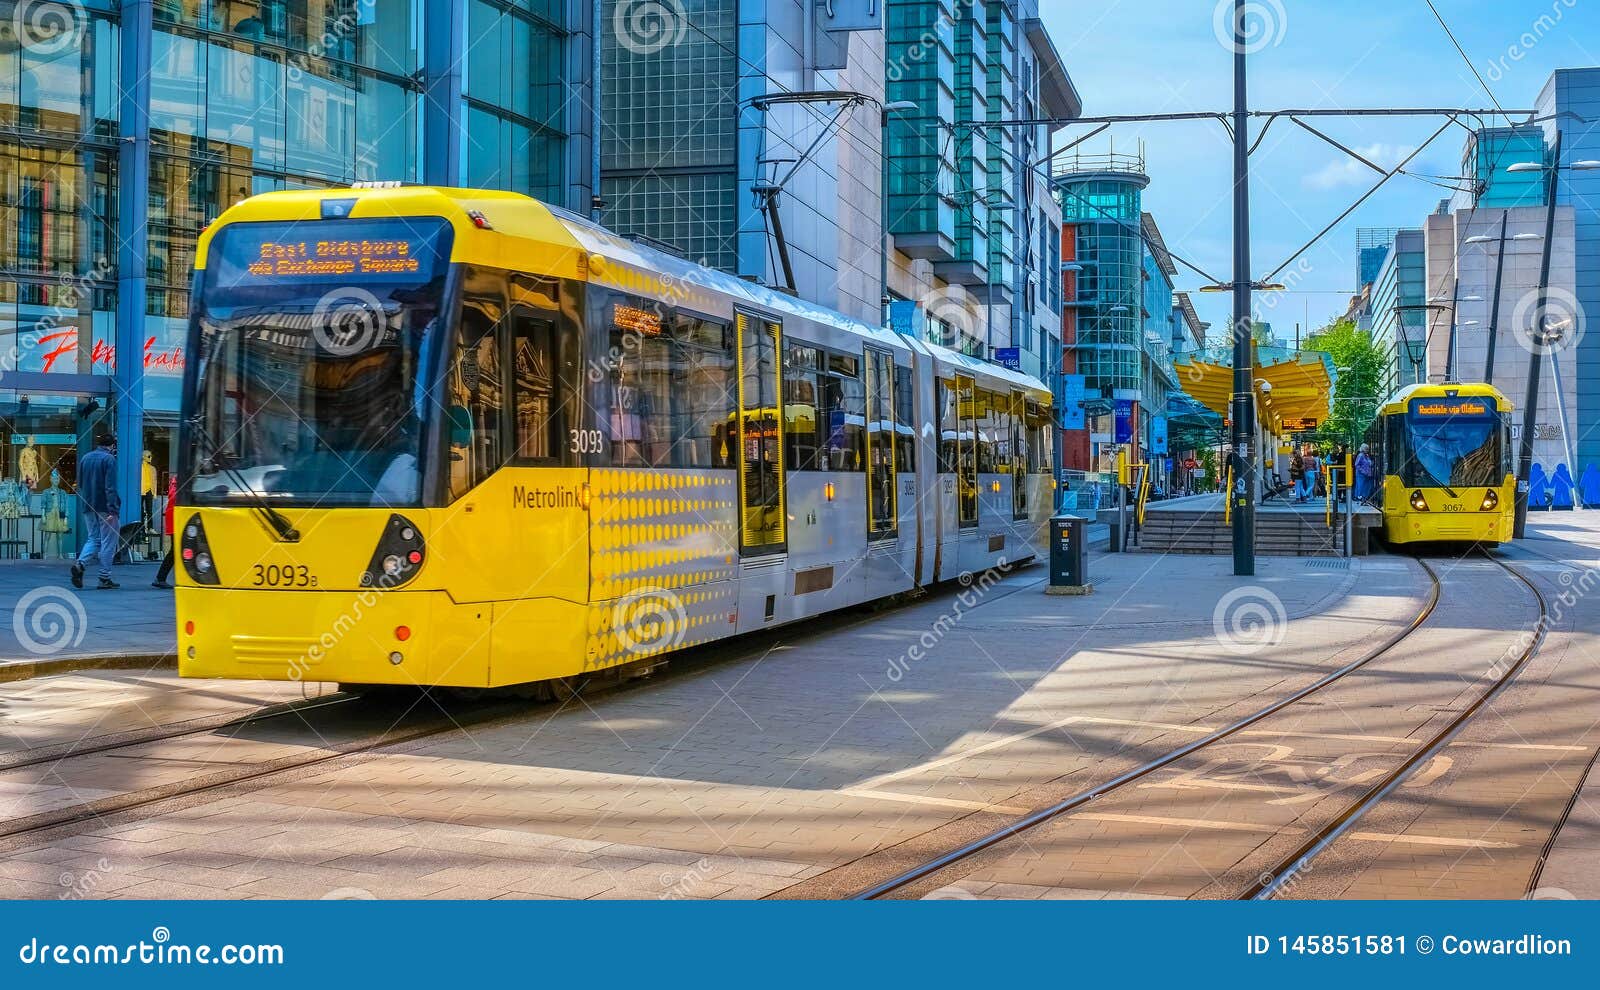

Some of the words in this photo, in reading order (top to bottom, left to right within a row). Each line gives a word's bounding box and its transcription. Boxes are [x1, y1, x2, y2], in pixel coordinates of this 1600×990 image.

[260, 243, 306, 258] East
[316, 240, 409, 256] Didsbury
[248, 262, 273, 275] via
[276, 259, 355, 275] Exchange
[360, 258, 418, 273] Square
[570, 429, 603, 454] 3093
[513, 485, 582, 509] Metrolink
